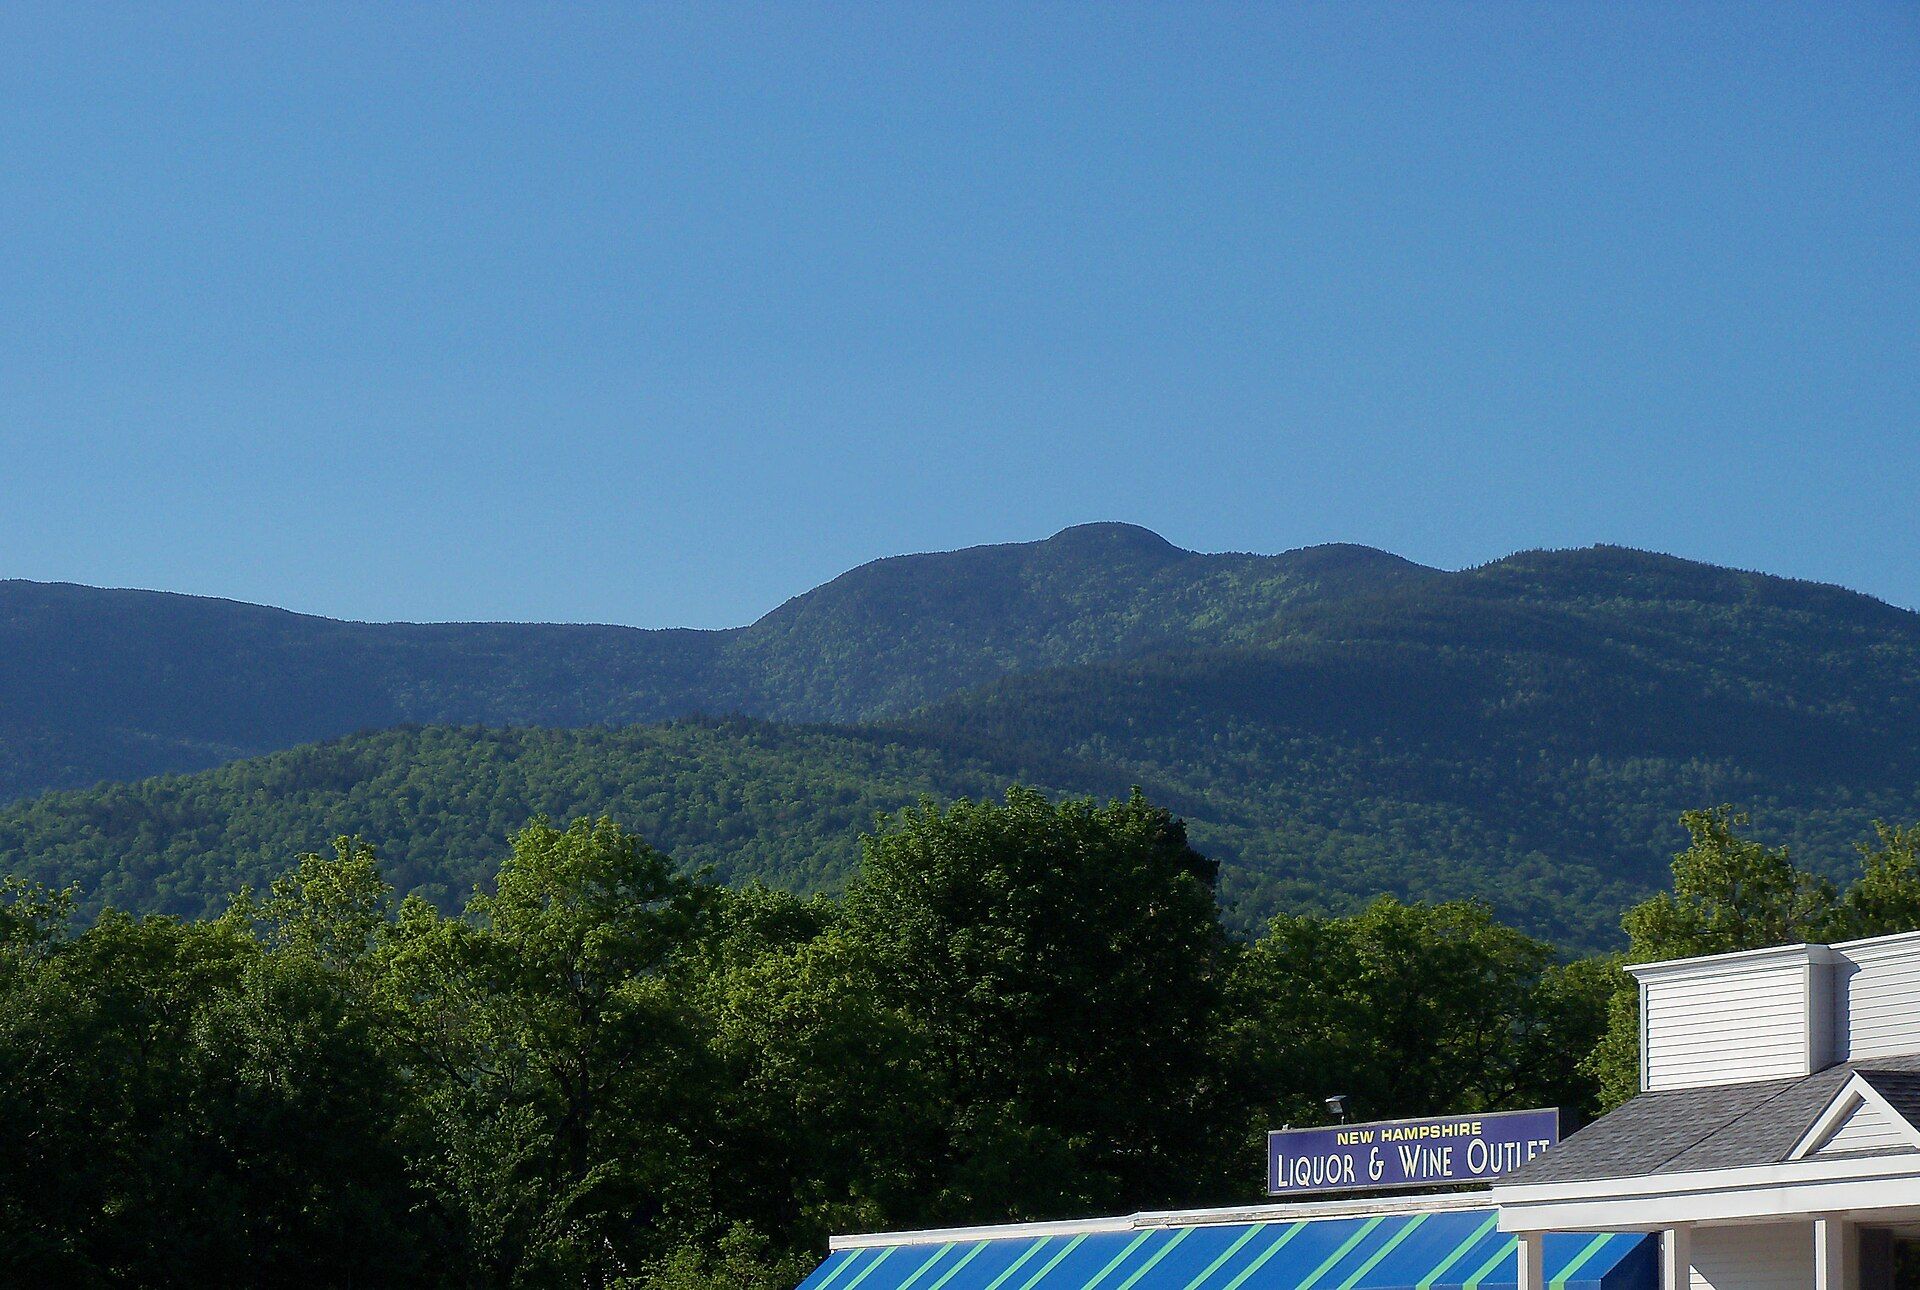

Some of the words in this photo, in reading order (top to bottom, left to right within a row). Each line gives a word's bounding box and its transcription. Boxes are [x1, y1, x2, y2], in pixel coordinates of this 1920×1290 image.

[1337, 1130, 1375, 1146] NEW
[1381, 1121, 1482, 1142] HAMPSHIRE
[1277, 1153, 1355, 1187] LIQUOR
[1368, 1146, 1384, 1181] &
[1397, 1144, 1453, 1178] WINE
